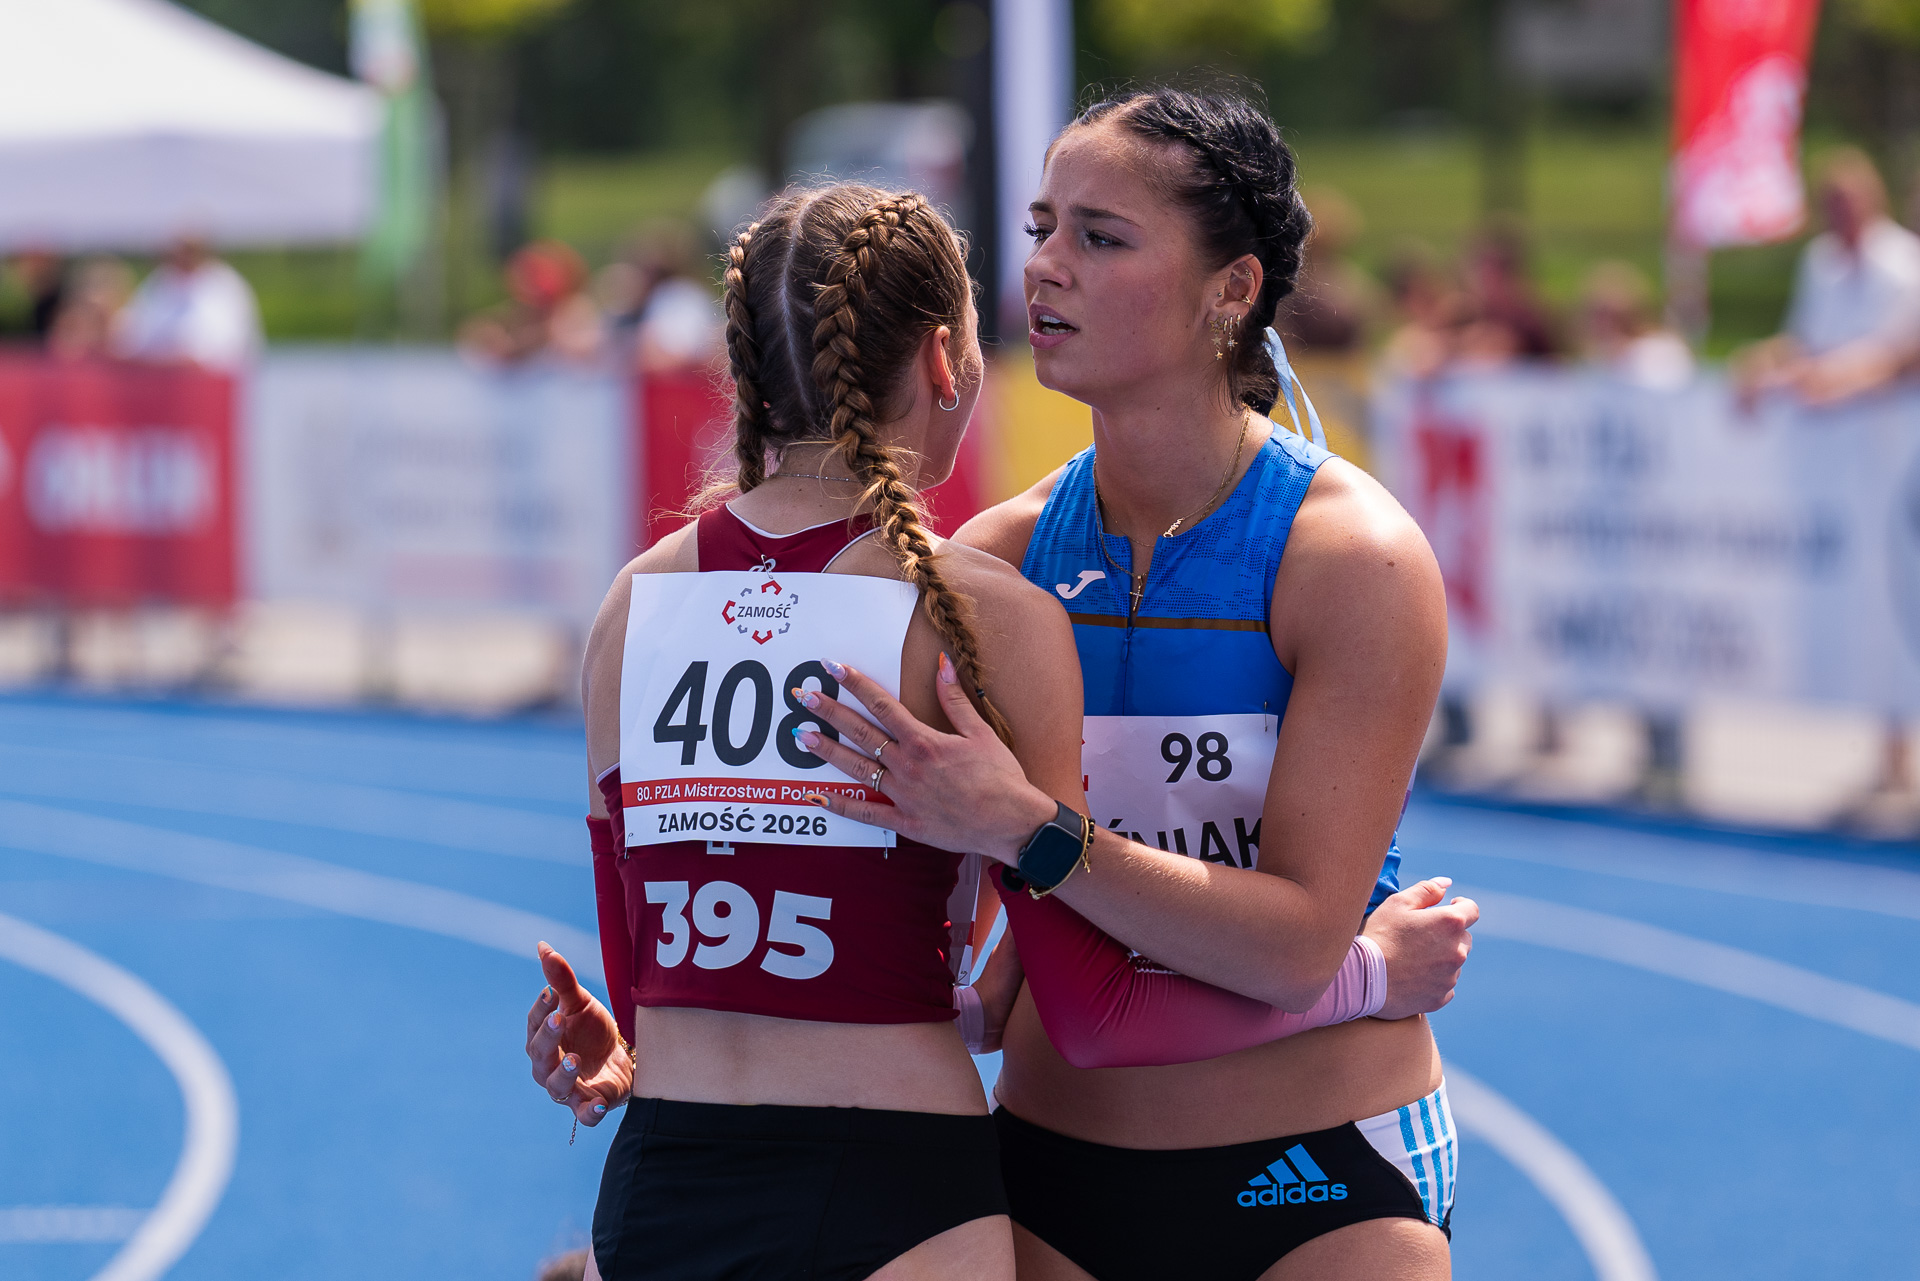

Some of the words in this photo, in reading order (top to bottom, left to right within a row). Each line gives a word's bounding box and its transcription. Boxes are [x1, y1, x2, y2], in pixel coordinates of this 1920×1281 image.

[737, 603, 791, 618] ZAMOŚĆ
[653, 659, 839, 769] 408
[1160, 731, 1232, 783] 98
[637, 786, 653, 801] 80.
[655, 784, 681, 799] PZLA
[684, 782, 776, 799] Mistrzostwa
[658, 806, 755, 833] ZAMOŚĆ
[762, 813, 827, 836] 2026
[644, 880, 834, 980] 395
[1237, 1182, 1348, 1207] adidas
